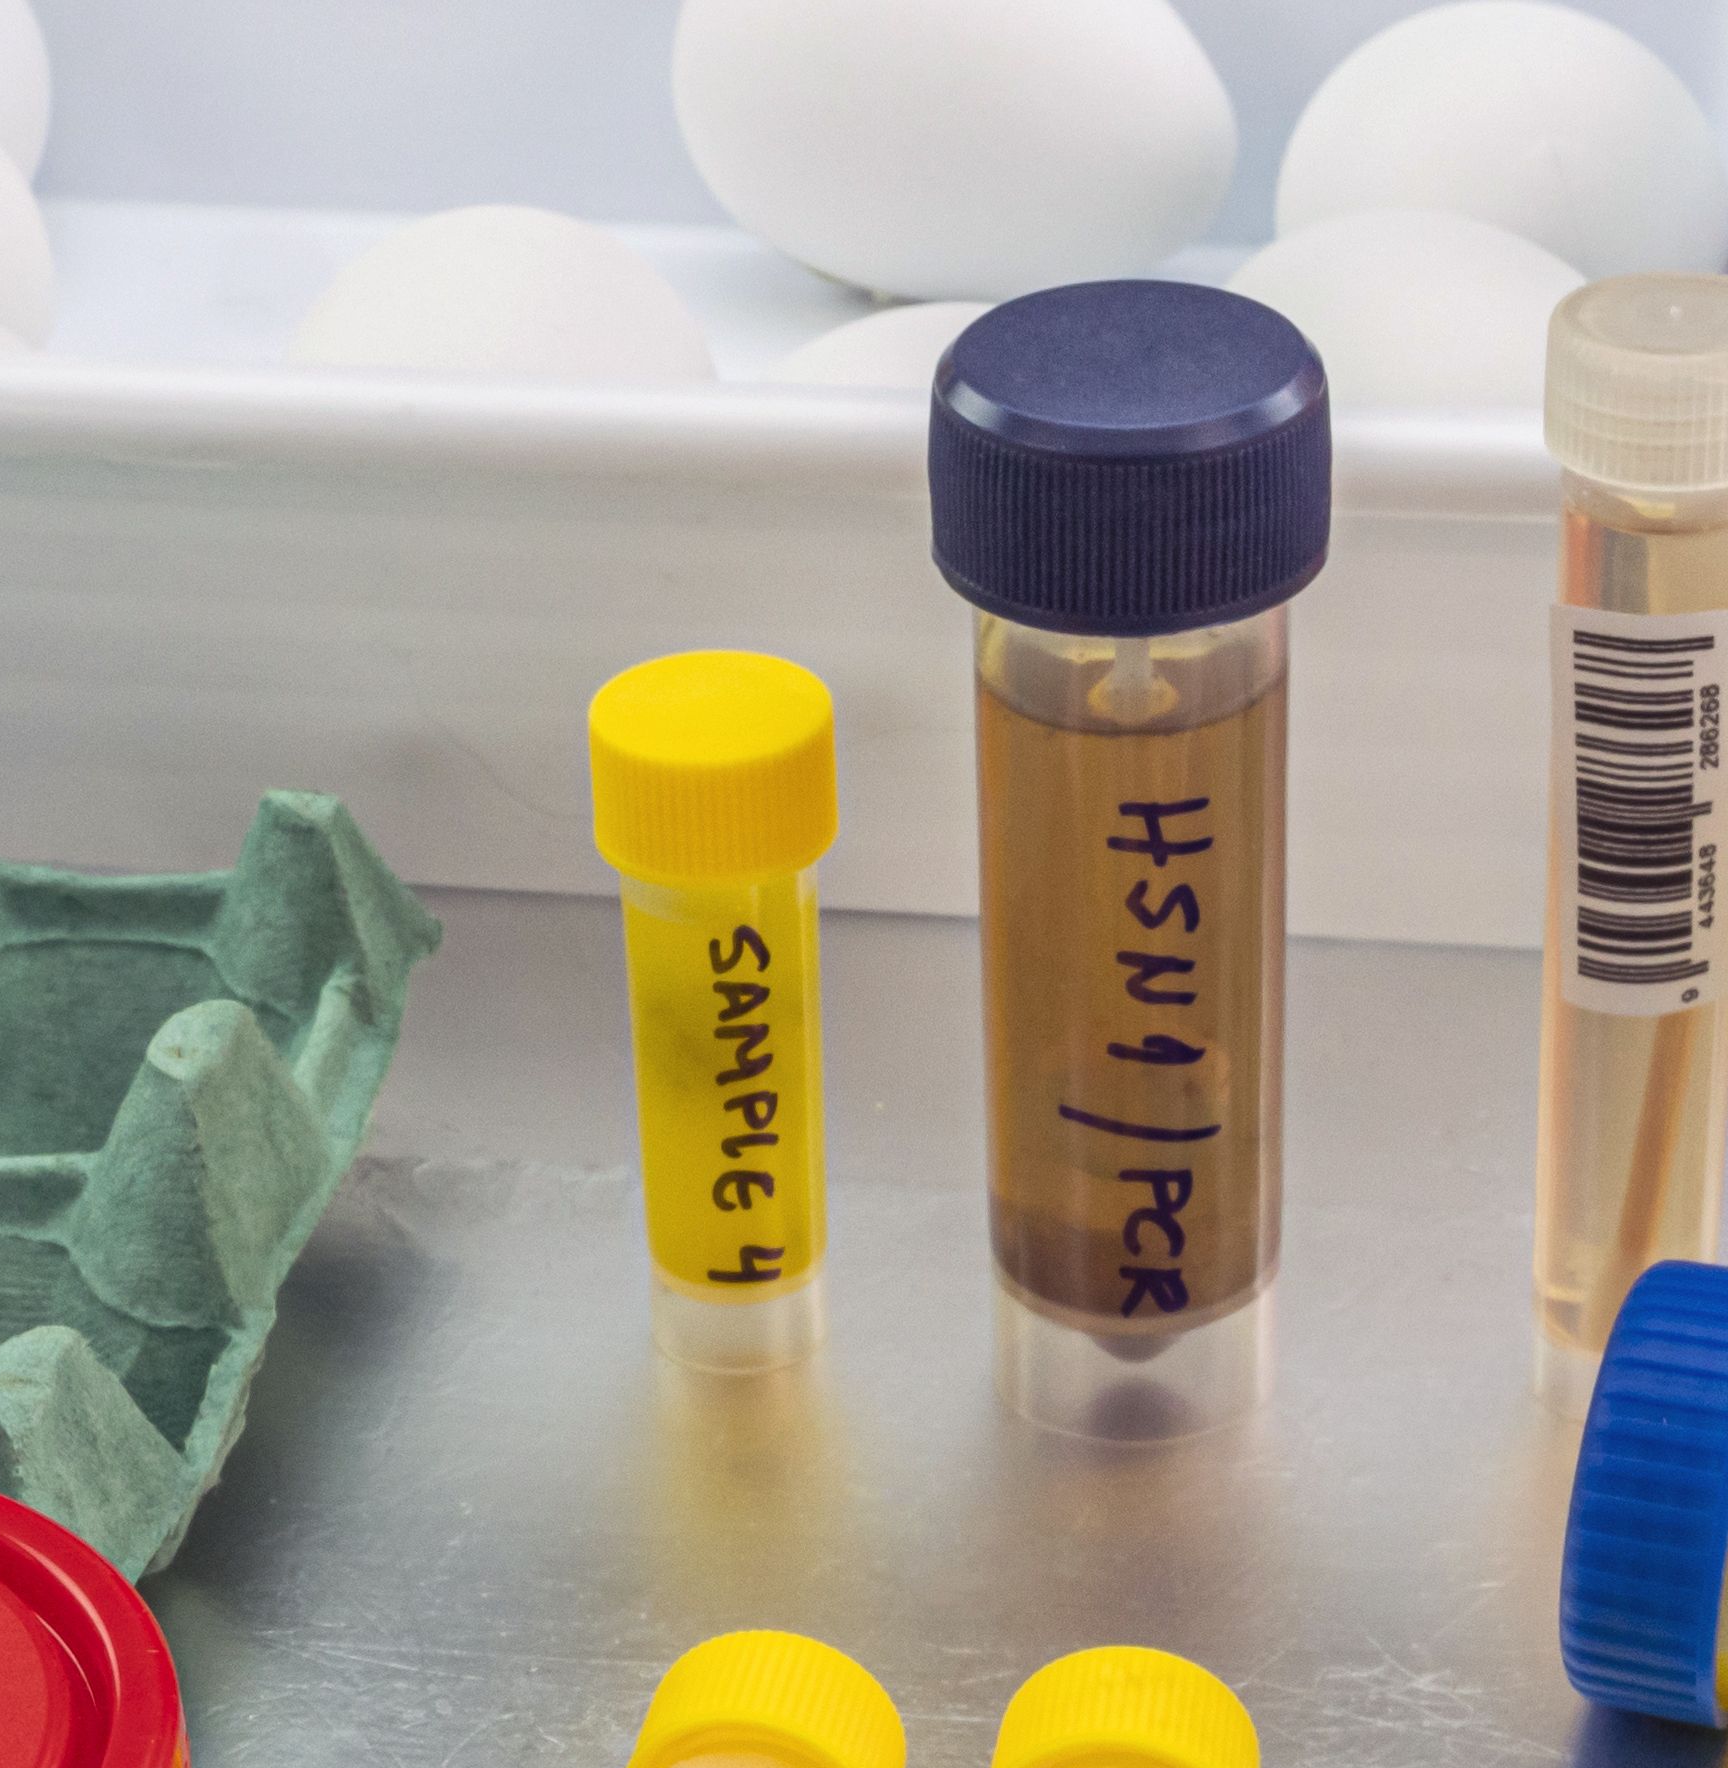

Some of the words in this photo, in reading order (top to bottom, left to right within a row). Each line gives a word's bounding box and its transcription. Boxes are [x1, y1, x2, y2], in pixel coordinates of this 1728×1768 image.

[1699, 683, 1721, 771] 286268
[1697, 843, 1718, 930] 443648
[708, 924, 780, 1212] SAMPLE
[706, 1244, 786, 1285] 4
